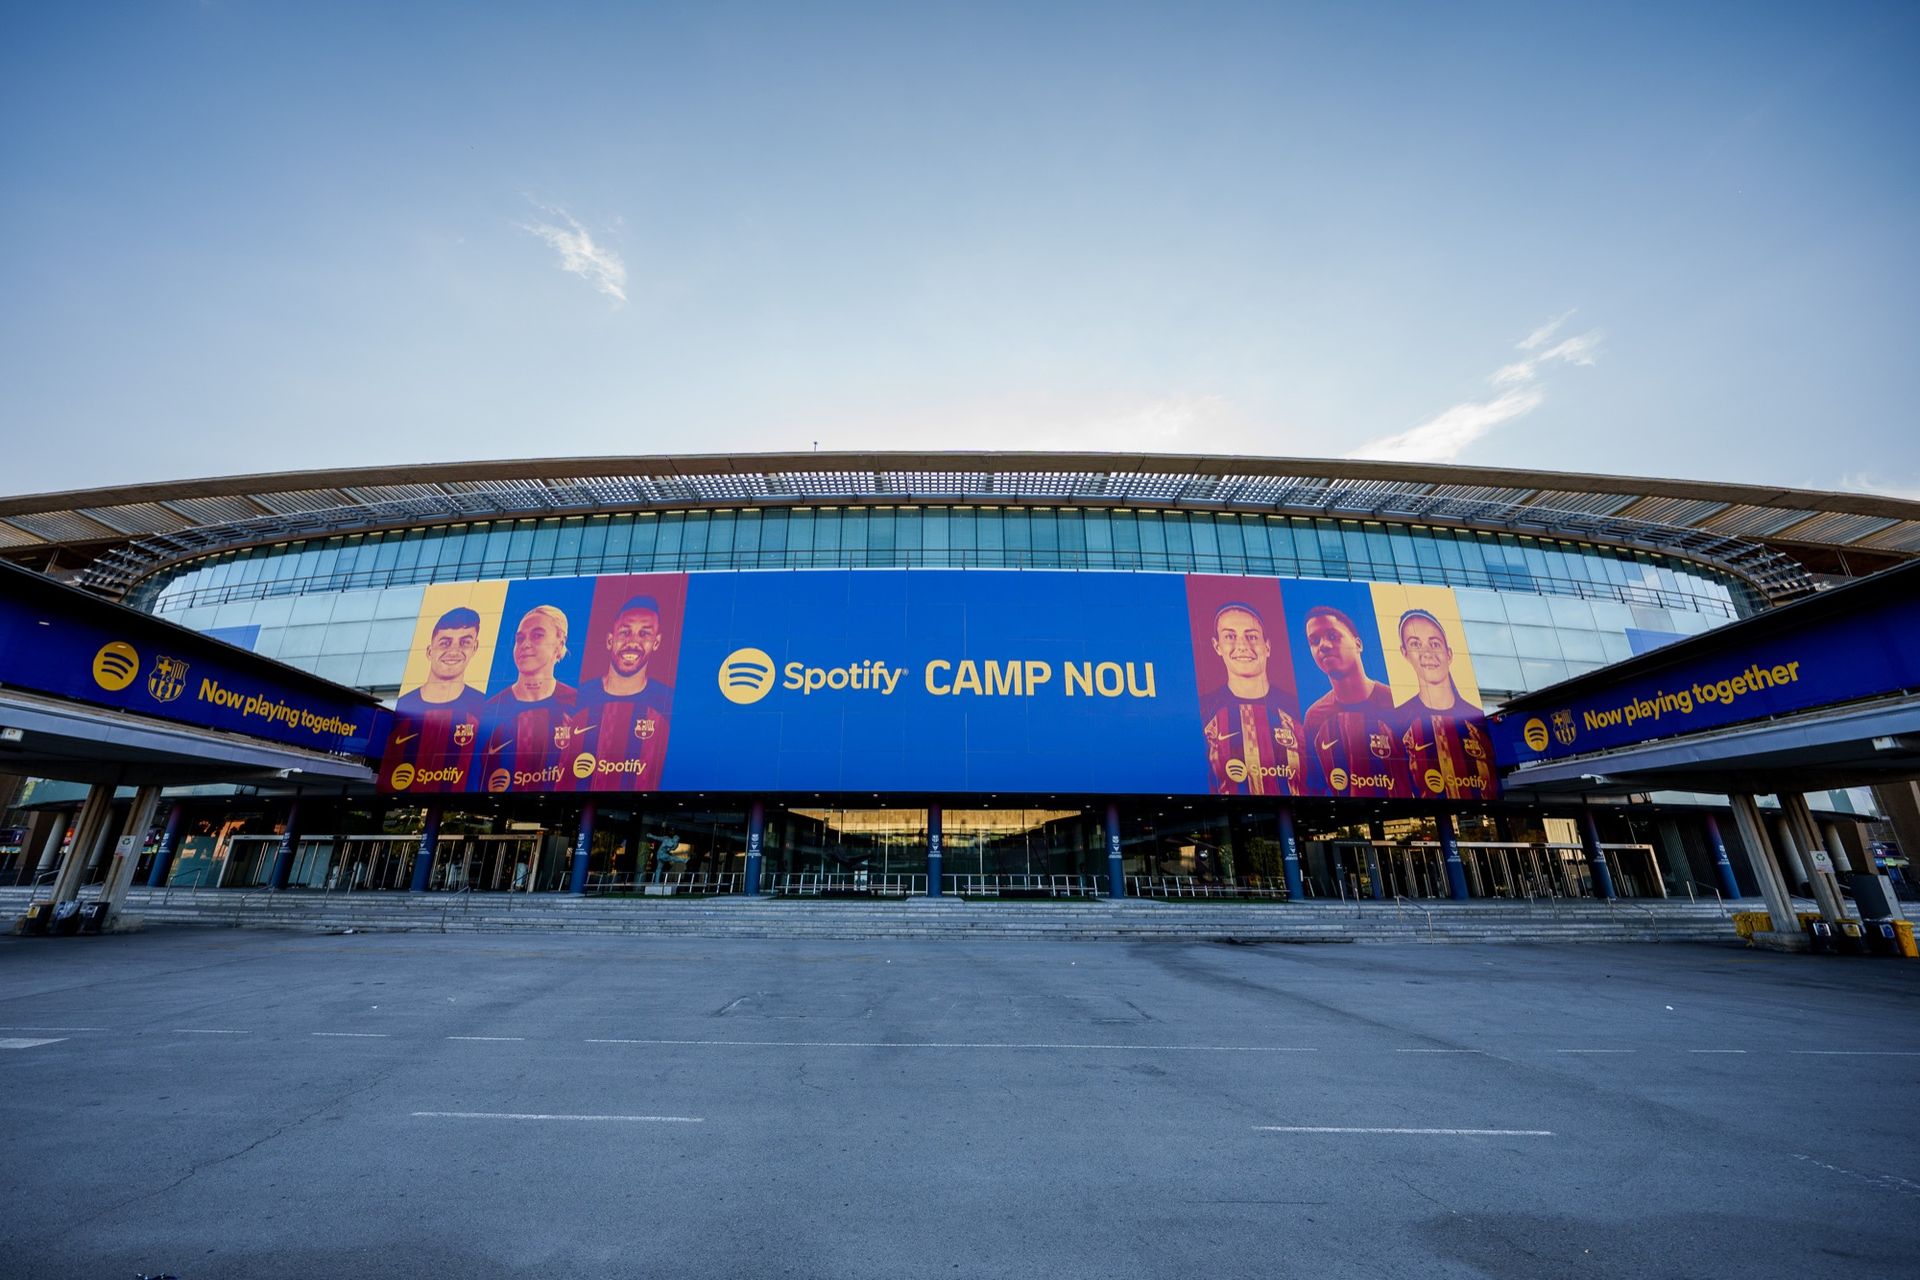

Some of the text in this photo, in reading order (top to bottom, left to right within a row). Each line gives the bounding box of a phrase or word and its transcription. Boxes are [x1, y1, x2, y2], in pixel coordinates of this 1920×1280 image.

[925, 660, 1051, 697] CAMP
[1064, 661, 1157, 698] NOU
[1583, 661, 1800, 731] Now playing together
[198, 678, 357, 737] Now playing together
[416, 767, 464, 784] Spotify
[598, 757, 646, 775] Spotify
[1250, 763, 1296, 782] Spotify
[513, 766, 565, 786] Spotify
[1350, 774, 1395, 791] Spotify
[1447, 773, 1488, 791] Spotify
